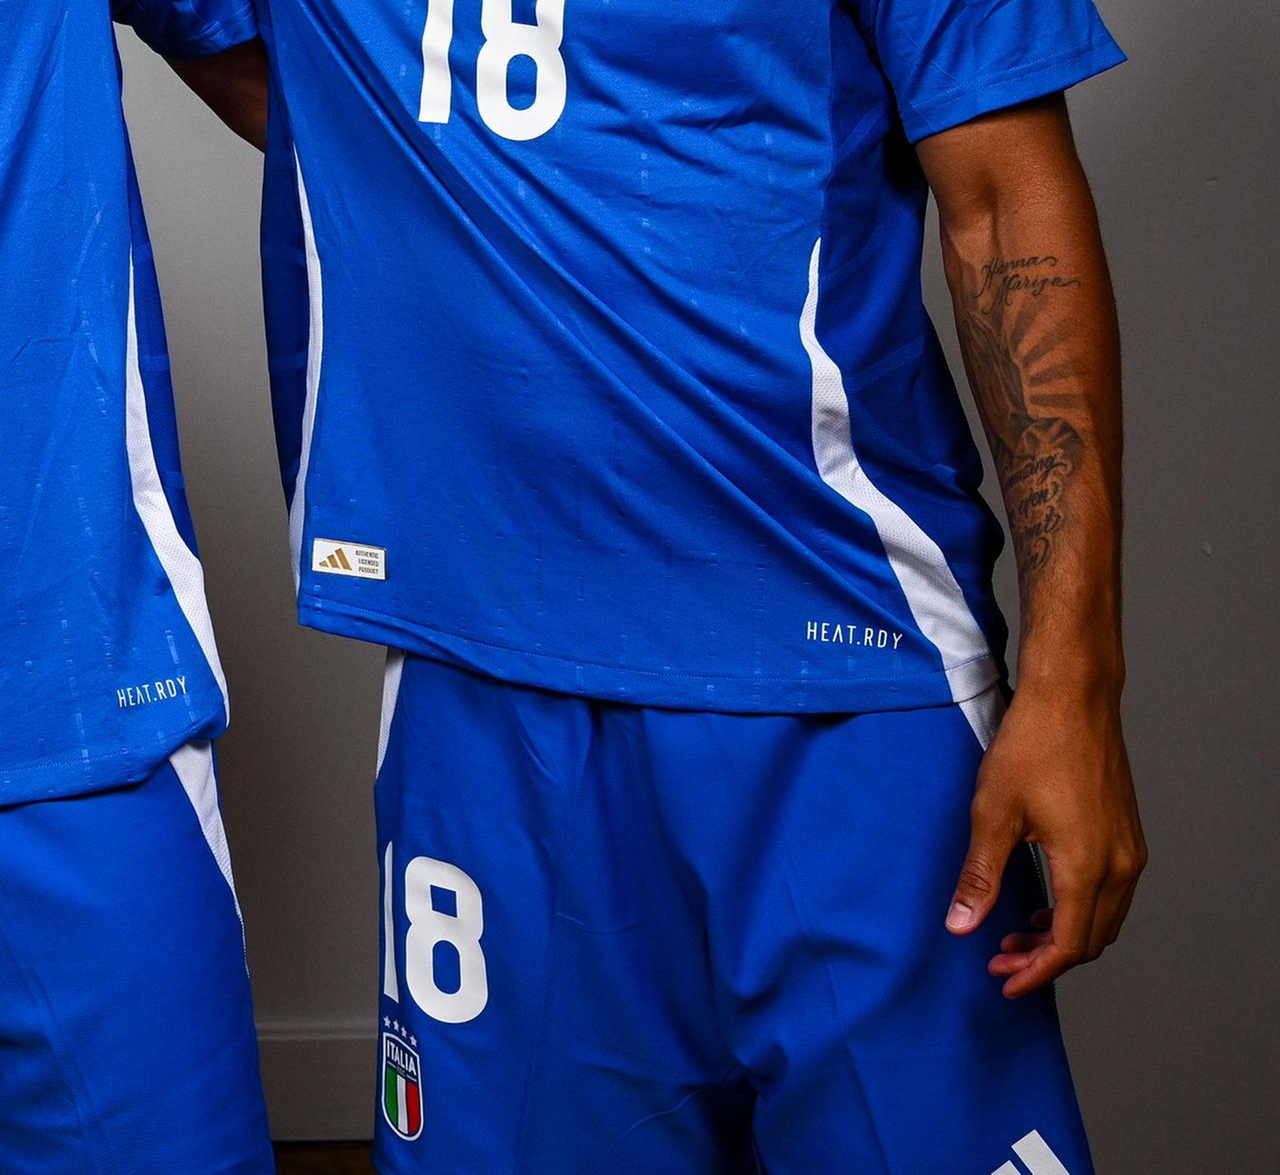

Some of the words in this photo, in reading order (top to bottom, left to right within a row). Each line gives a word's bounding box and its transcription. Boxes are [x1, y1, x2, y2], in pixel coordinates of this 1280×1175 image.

[807, 621, 902, 649] HEAT.RDY
[116, 675, 187, 708] HEAT.RDY
[384, 842, 488, 1023] 18
[386, 1039, 417, 1076] ITALIA
